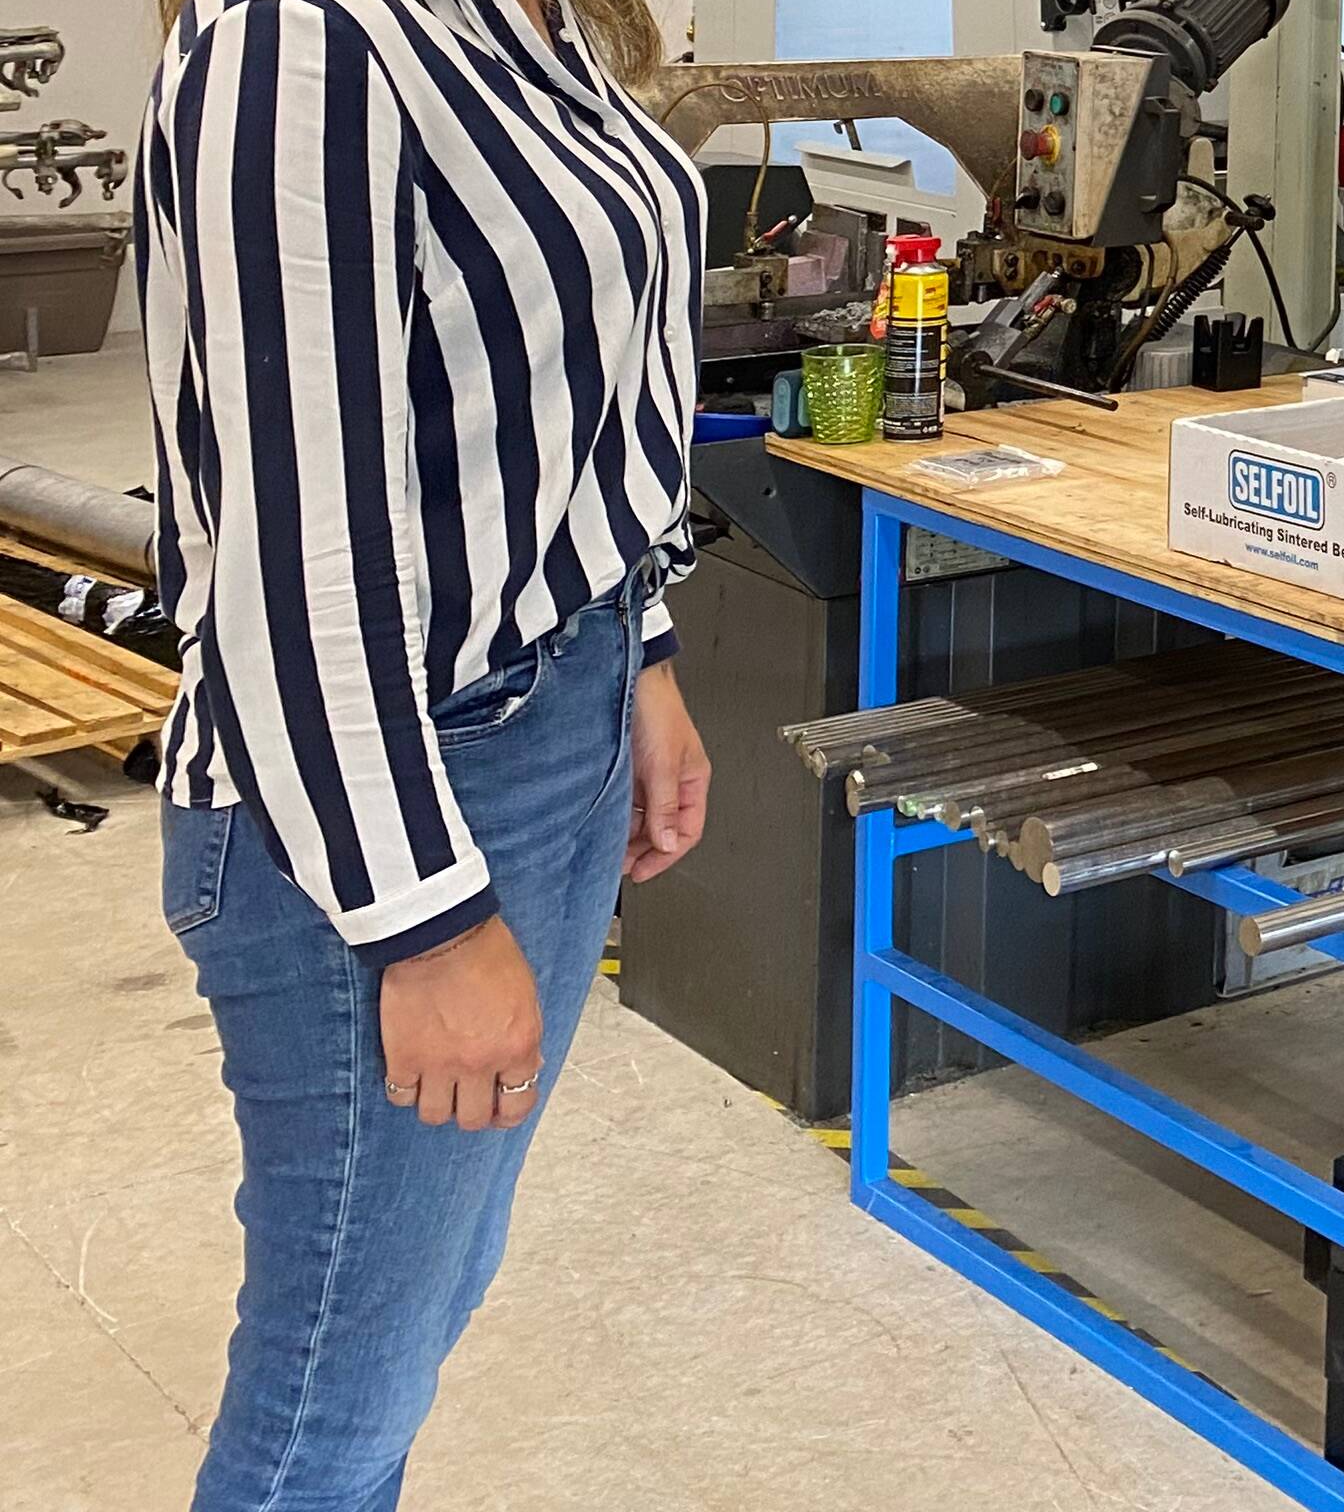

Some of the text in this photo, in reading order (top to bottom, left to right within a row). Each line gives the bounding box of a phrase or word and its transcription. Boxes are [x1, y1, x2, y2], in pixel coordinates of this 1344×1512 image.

[720, 71, 881, 102] OPTIMUM
[1234, 461, 1318, 520] SELFOIL
[1184, 502, 1273, 542] Self-Lubricating
[1277, 528, 1328, 553] Sintered
[1245, 543, 1319, 570] www.selfoil.com
